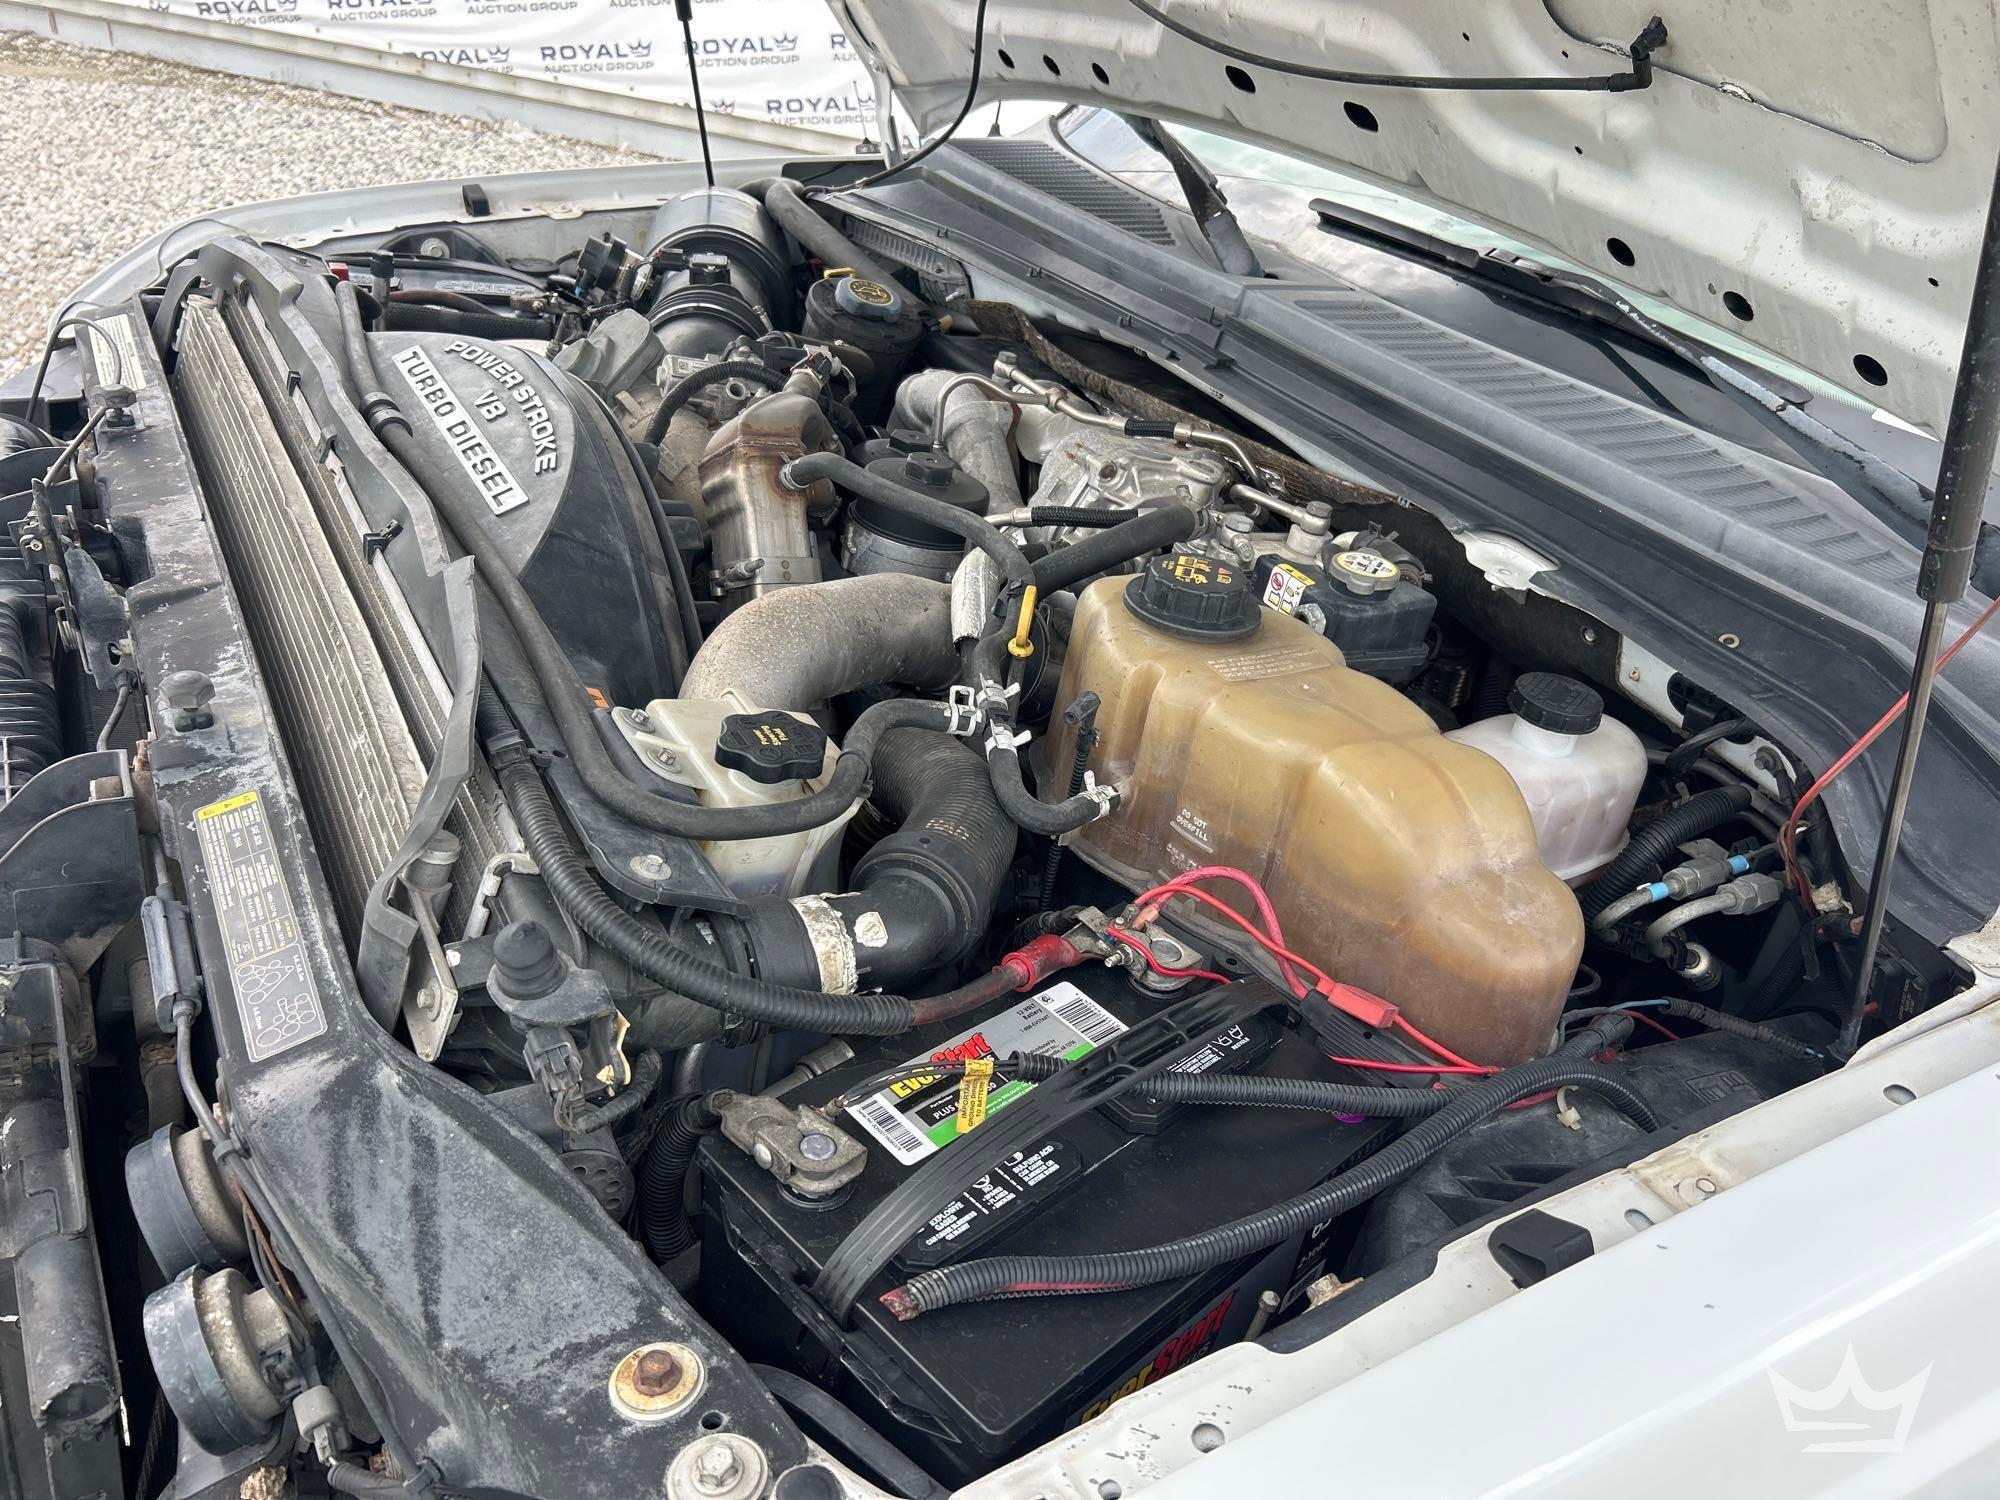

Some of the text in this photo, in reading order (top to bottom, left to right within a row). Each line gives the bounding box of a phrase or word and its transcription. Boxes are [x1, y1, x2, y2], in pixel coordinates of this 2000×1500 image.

[540, 43, 628, 60] ROYAL
[767, 96, 857, 114] ROYAL
[444, 340, 524, 390] POWER
[512, 384, 558, 475] STROKE
[474, 388, 508, 422] V8
[400, 351, 514, 508] TURBO DIESEL
[1176, 816, 1208, 842] OVERFILL
[1182, 808, 1208, 830] DO NOT
[1022, 1008, 1042, 1020] Battery
[932, 1106, 955, 1120] PLUS
[967, 1100, 976, 1126] GROUND
[1012, 1145, 1054, 1174] SULFURIC ACID
[982, 1184, 994, 1194] NO
[928, 1202, 964, 1226] EXPLOSIVE
[934, 1214, 958, 1231] GASES
